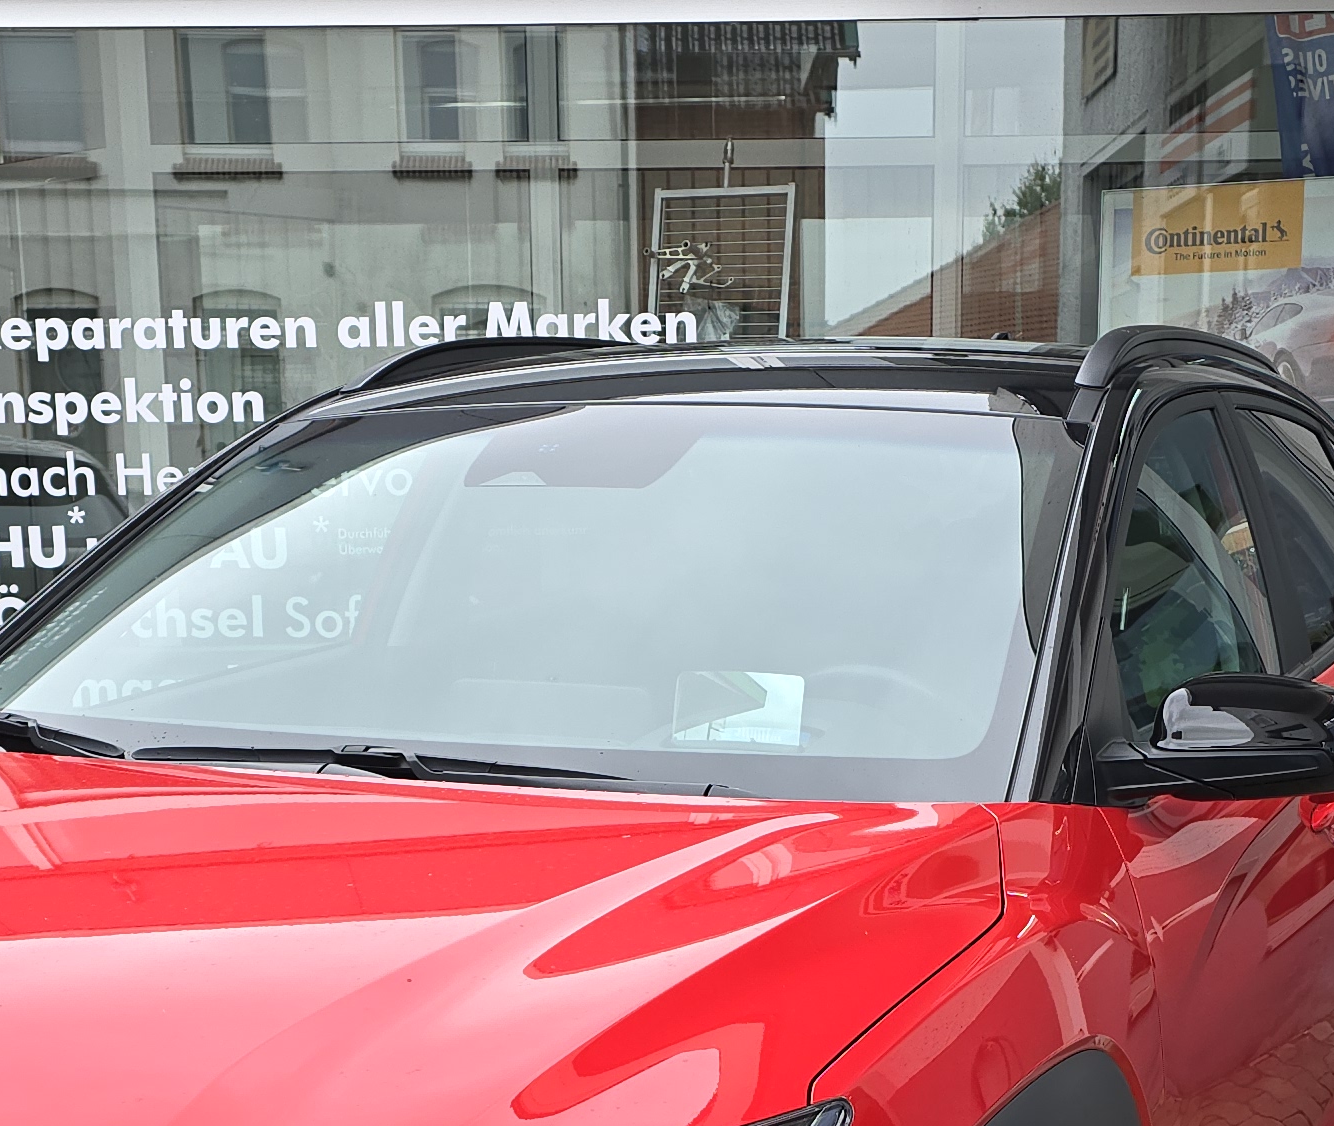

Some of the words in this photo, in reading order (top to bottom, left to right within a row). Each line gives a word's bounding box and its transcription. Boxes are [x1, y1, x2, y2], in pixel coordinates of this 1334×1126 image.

[1145, 222, 1267, 254] Continental
[1174, 252, 1190, 261] The
[1192, 252, 1221, 260] Future
[1235, 249, 1267, 258] Motion
[337, 300, 466, 347] aller
[486, 298, 698, 343] Marken
